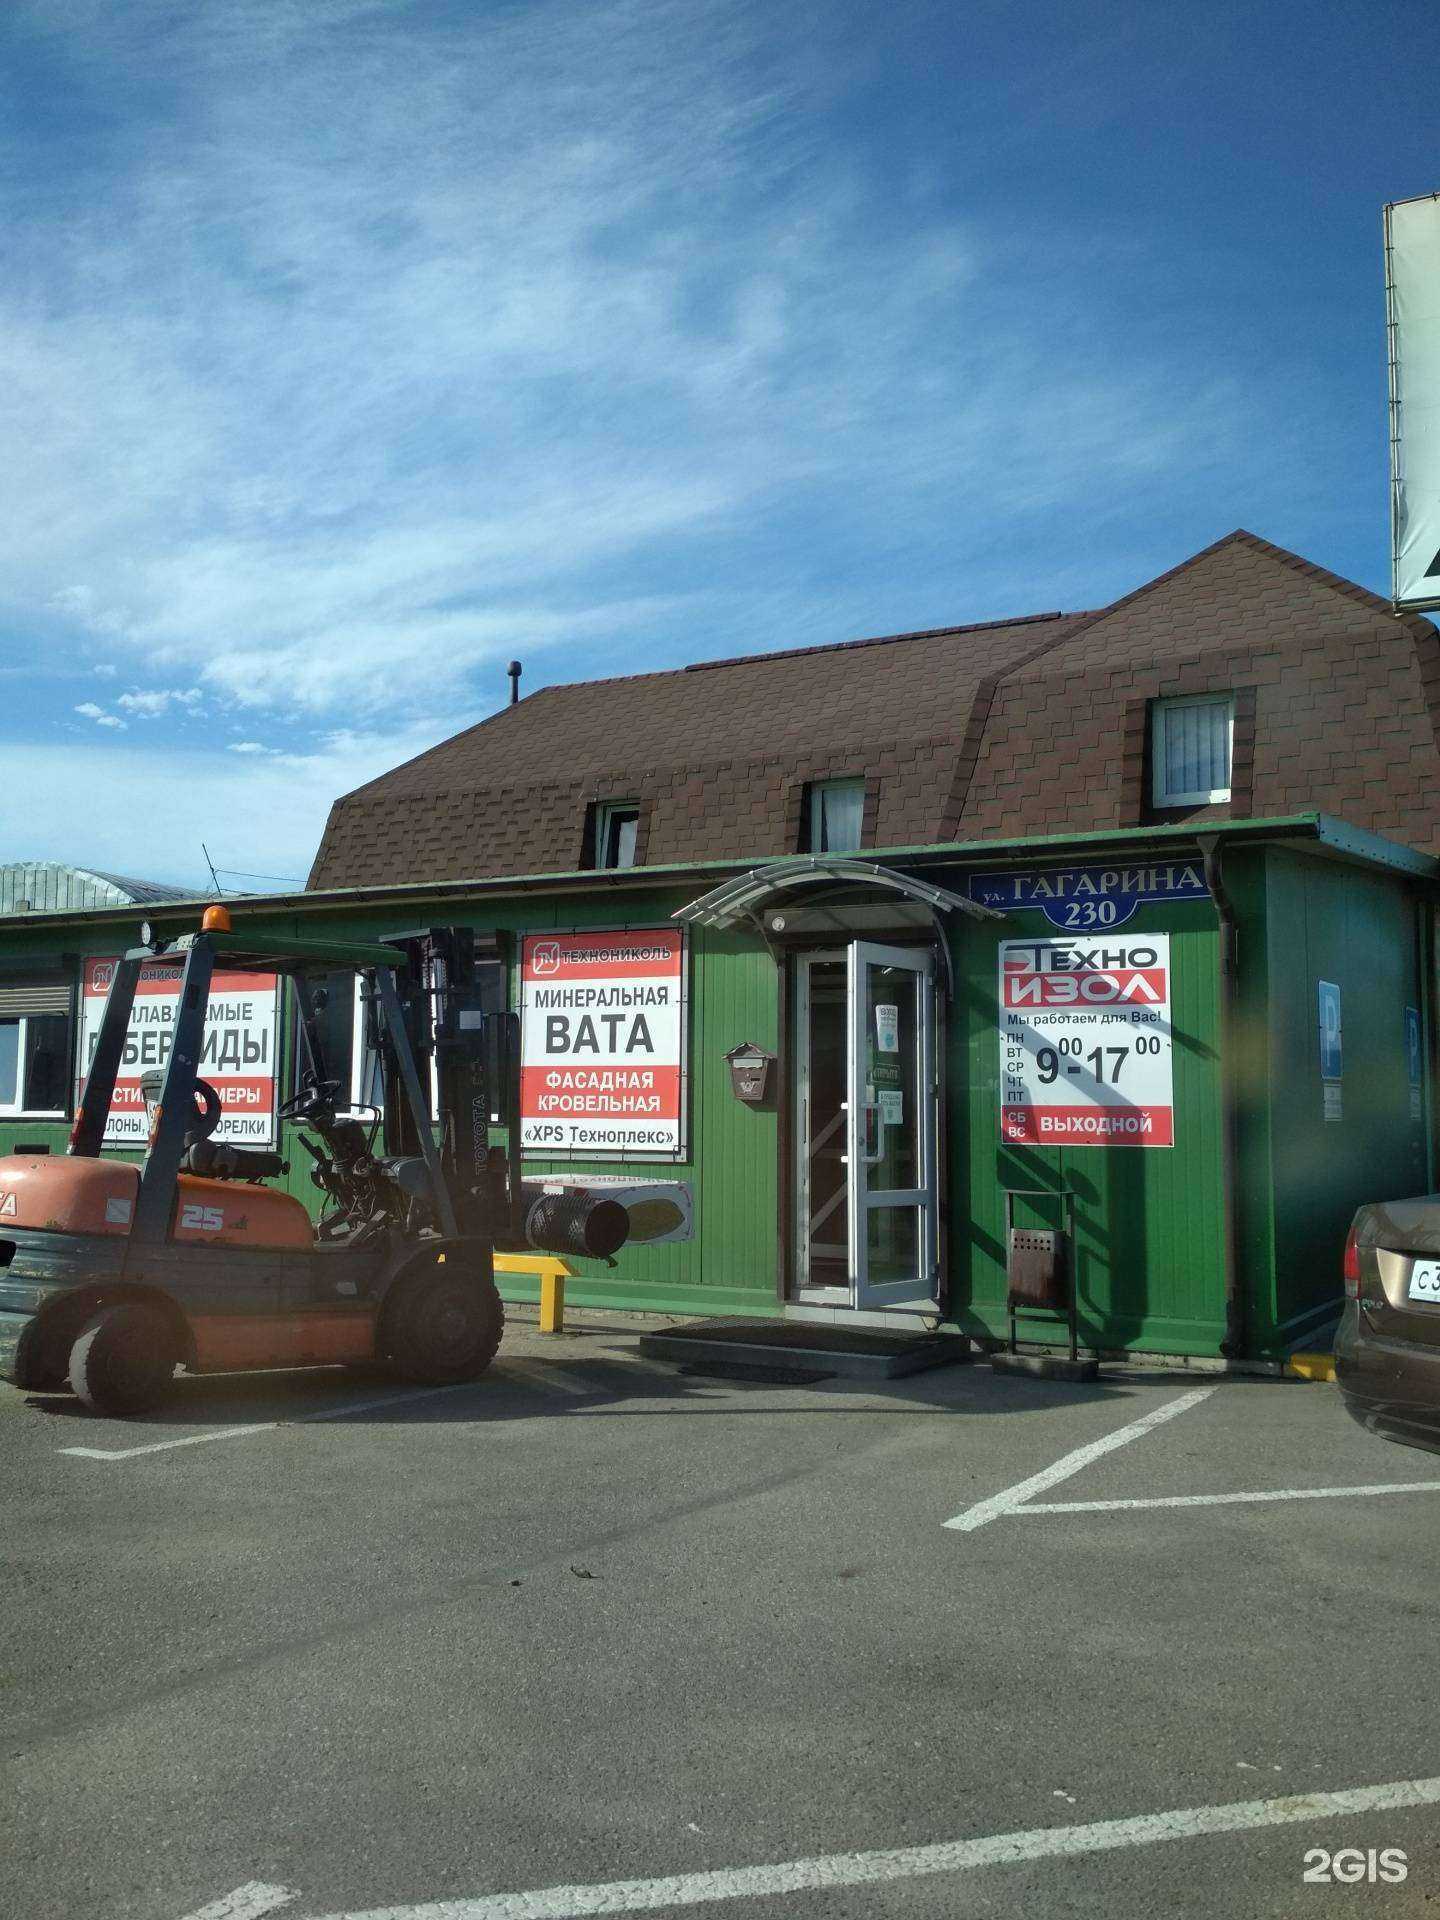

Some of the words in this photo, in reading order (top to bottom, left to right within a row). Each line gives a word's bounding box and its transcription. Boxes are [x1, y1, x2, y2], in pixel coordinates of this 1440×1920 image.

[983, 893, 1005, 905] ул.
[1013, 866, 1203, 899] ГАГАРИНА
[1065, 901, 1116, 926] 230
[561, 946, 672, 964] ТЕХНОНИКОЛЬ
[1004, 942, 1158, 972] ТЕХНО
[535, 986, 669, 1008] МИНЕРАЛЬНАЯ
[1011, 973, 1161, 1004] ИЗОЛ
[1008, 1014, 1029, 1025] Мы
[1034, 1012, 1097, 1027] работаем
[1101, 1012, 1127, 1025] для
[1132, 1011, 1161, 1022] Вас!
[545, 1013, 655, 1053] ВАТА
[1007, 1033, 1024, 1044] ПН
[88, 1028, 267, 1072] БЕРИДЫ
[1007, 1048, 1022, 1058] ВТ
[1007, 1062, 1024, 1073] СР
[546, 1071, 654, 1091] ФАСАДНАЯ
[1007, 1077, 1024, 1087] ЧТ
[538, 1095, 661, 1112] КРОВЕЛЬНАЯ
[1008, 1092, 1024, 1102] ПТ
[1008, 1112, 1026, 1123] СБ
[1040, 1112, 1153, 1135] ВЫХОДНОЙ
[215, 1120, 265, 1135] ОРЕЛКИ
[473, 1094, 488, 1176] TOYOTA
[525, 1125, 564, 1142] «XPS
[570, 1126, 674, 1143] Техноплекс»
[1008, 1126, 1026, 1138] ВС
[182, 1205, 225, 1231] 25
